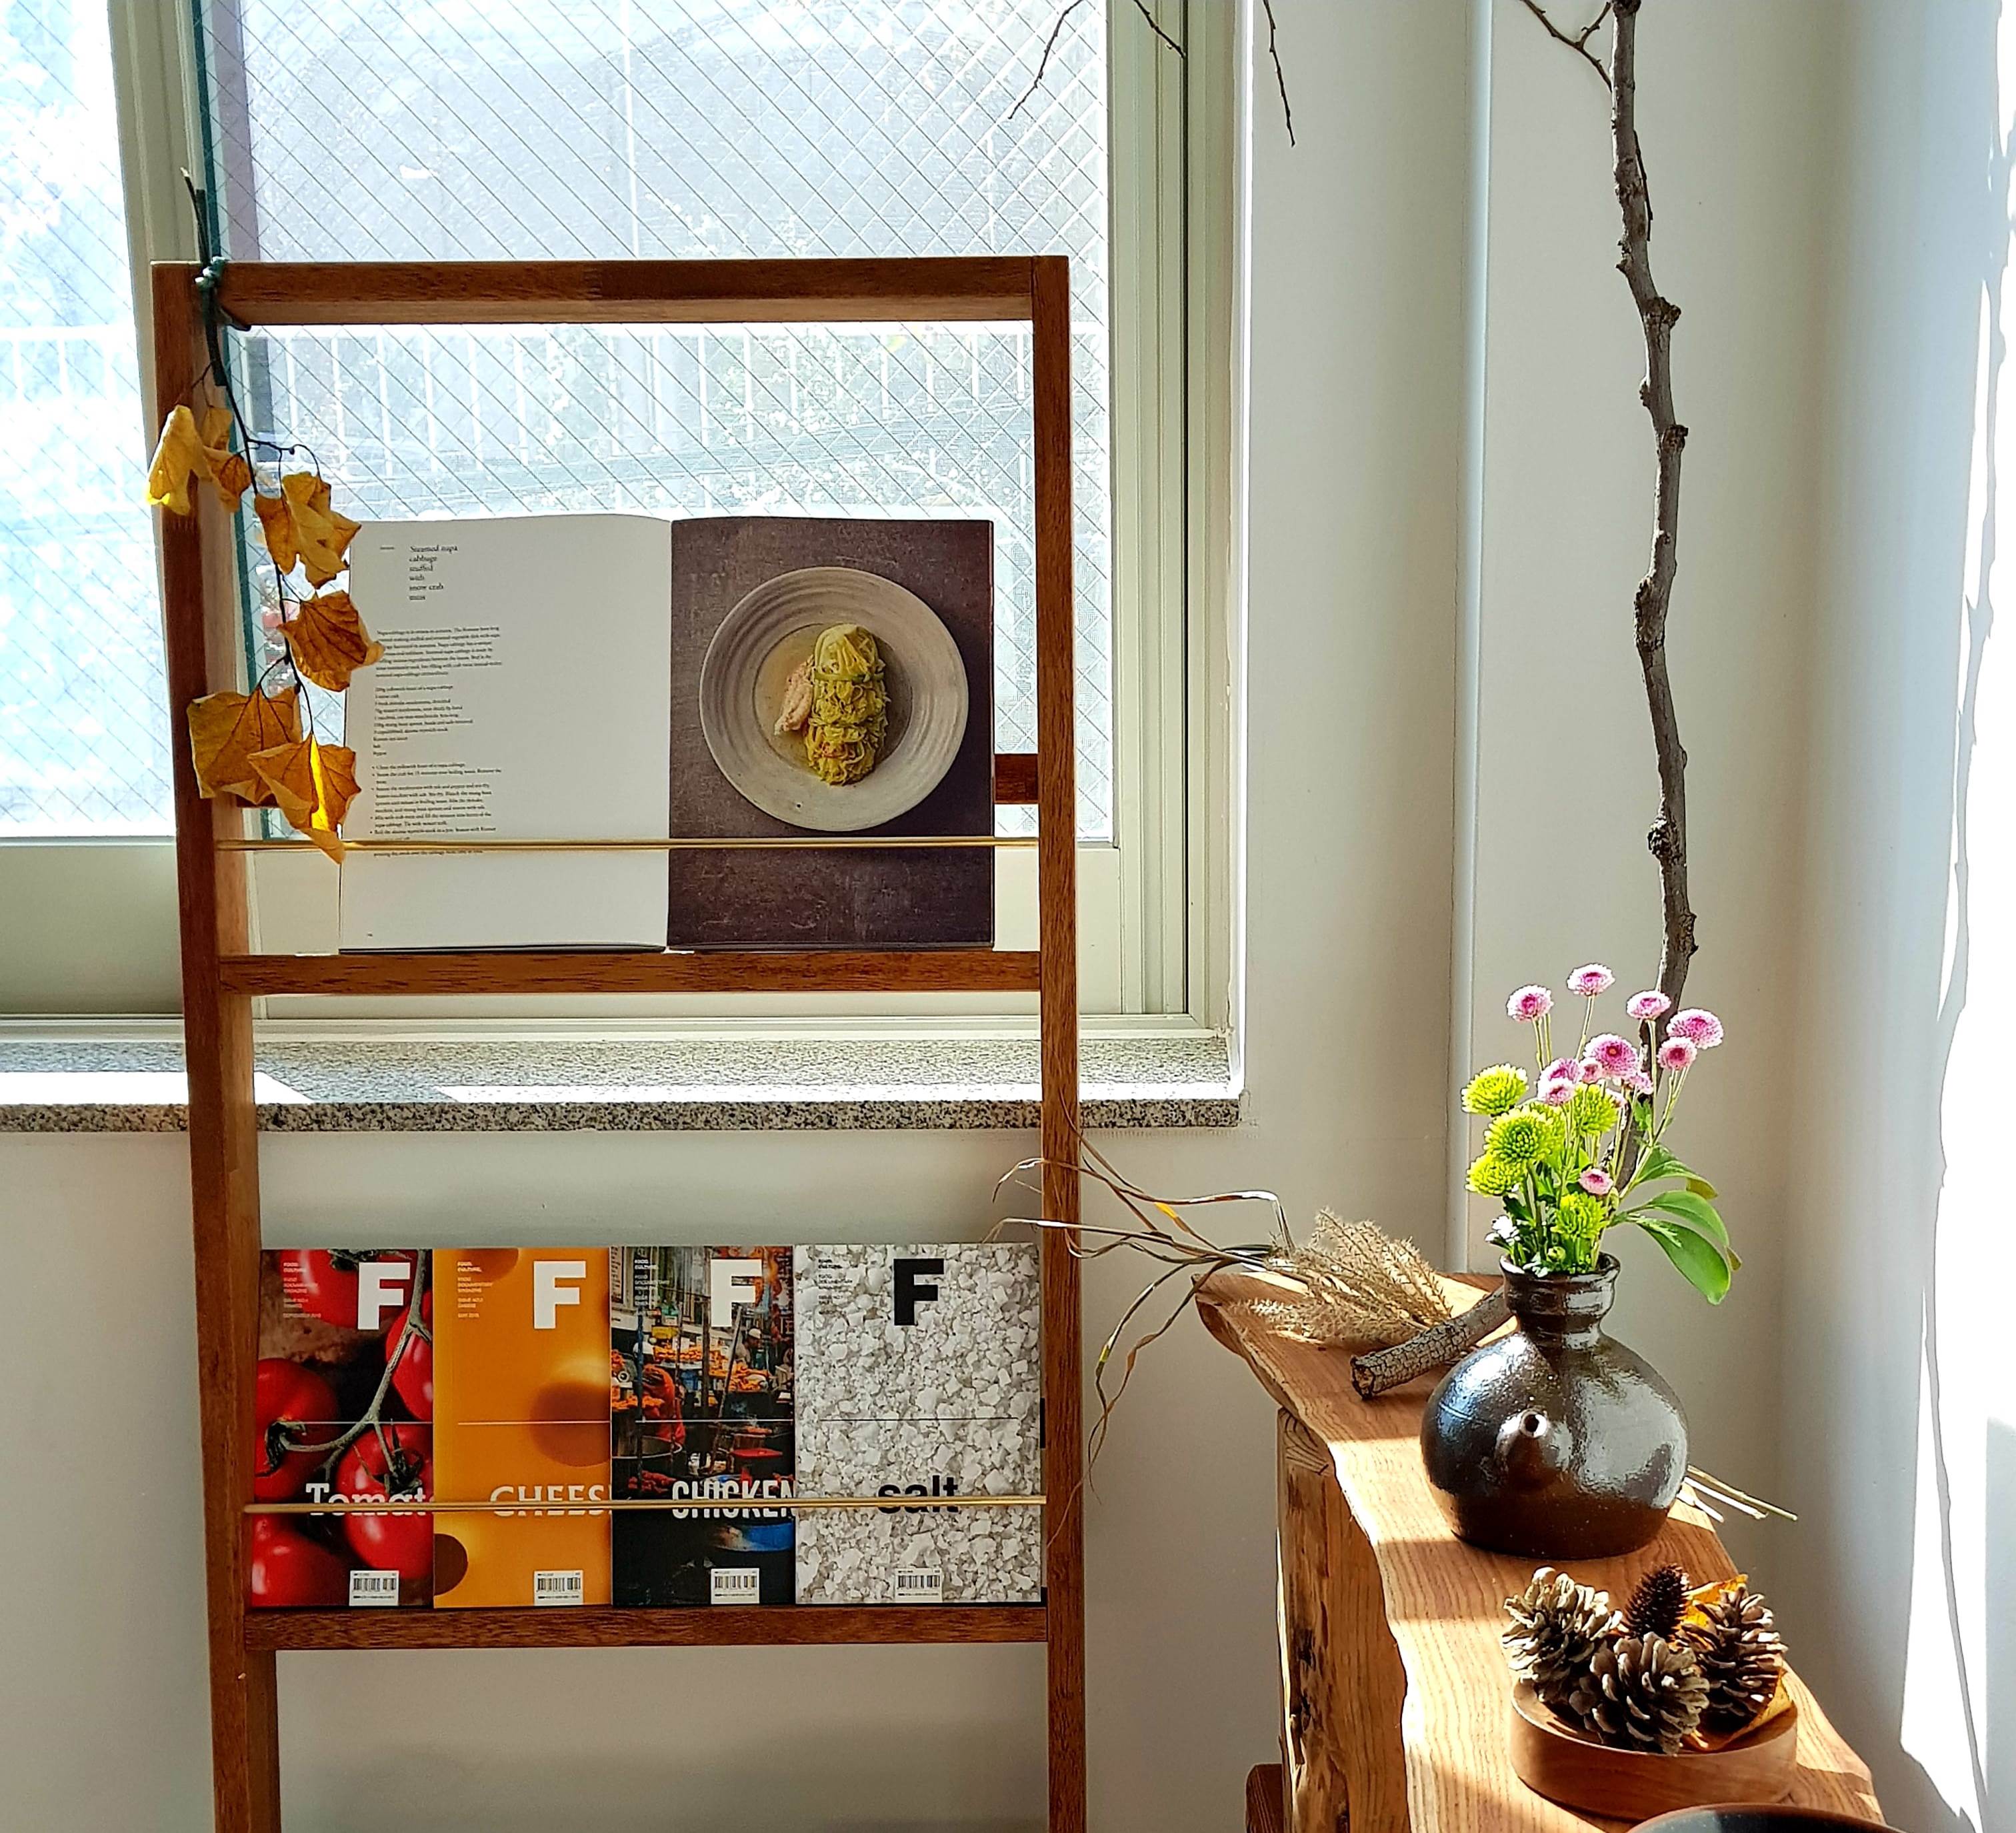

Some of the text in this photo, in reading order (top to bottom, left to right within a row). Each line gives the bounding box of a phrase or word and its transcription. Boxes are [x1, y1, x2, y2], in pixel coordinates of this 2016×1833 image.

[358, 1262, 411, 1330] F
[533, 1261, 587, 1329] F
[711, 1259, 762, 1327] F
[893, 1258, 945, 1326] F
[305, 1483, 434, 1516] Tomat
[490, 1485, 612, 1517] CHEES
[878, 1475, 959, 1514] salt
